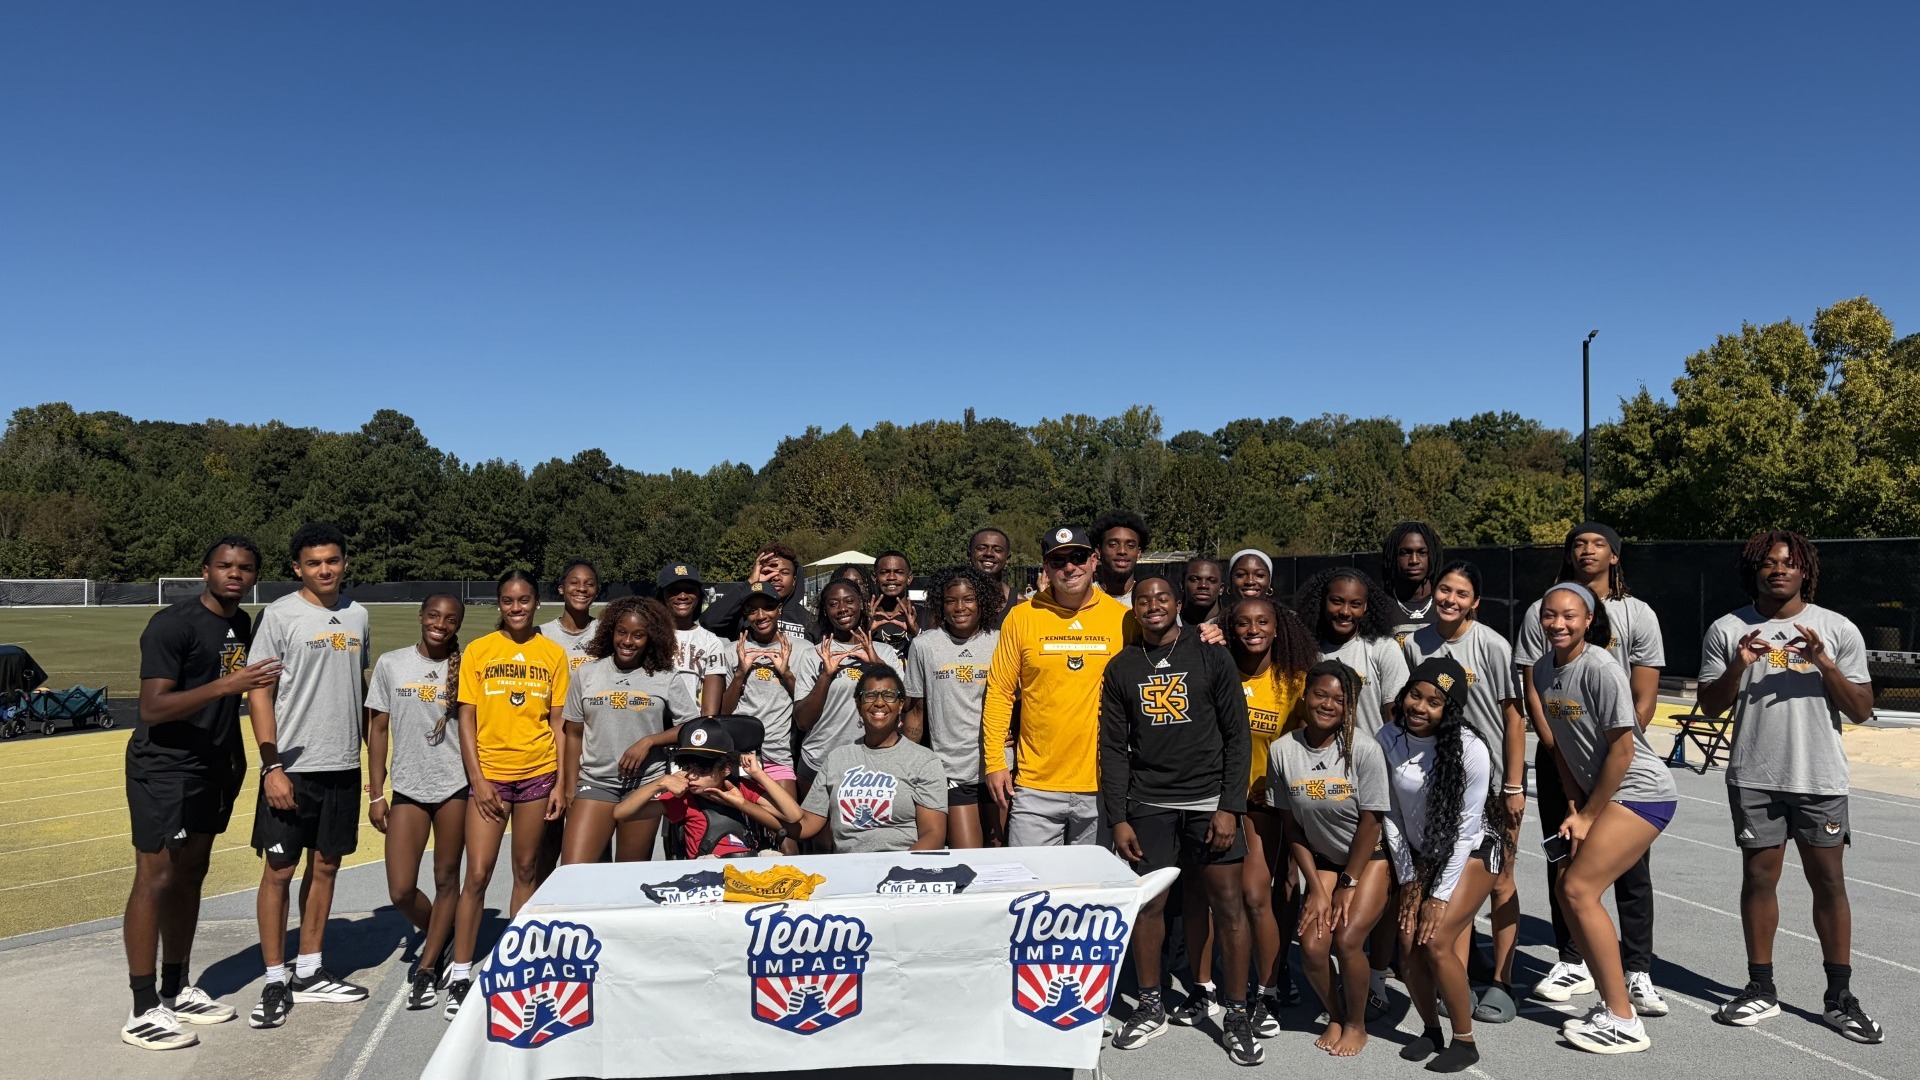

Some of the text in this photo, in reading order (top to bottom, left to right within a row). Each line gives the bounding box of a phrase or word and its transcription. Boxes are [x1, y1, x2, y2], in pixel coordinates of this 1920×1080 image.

[485, 664, 552, 683] KENNESAW STATE
[1250, 720, 1278, 731] FIELD
[1254, 712, 1279, 723] STATE
[841, 766, 896, 789] Team
[839, 789, 895, 799] IMPACT
[668, 889, 722, 903] MPAC
[882, 883, 954, 893] IMPACT
[1013, 892, 1124, 944] Team
[750, 903, 868, 956] Team
[483, 925, 597, 972] eam
[1014, 944, 1120, 961] IMPACT
[752, 954, 865, 974] IMPACT
[484, 962, 595, 993] IMPACT
